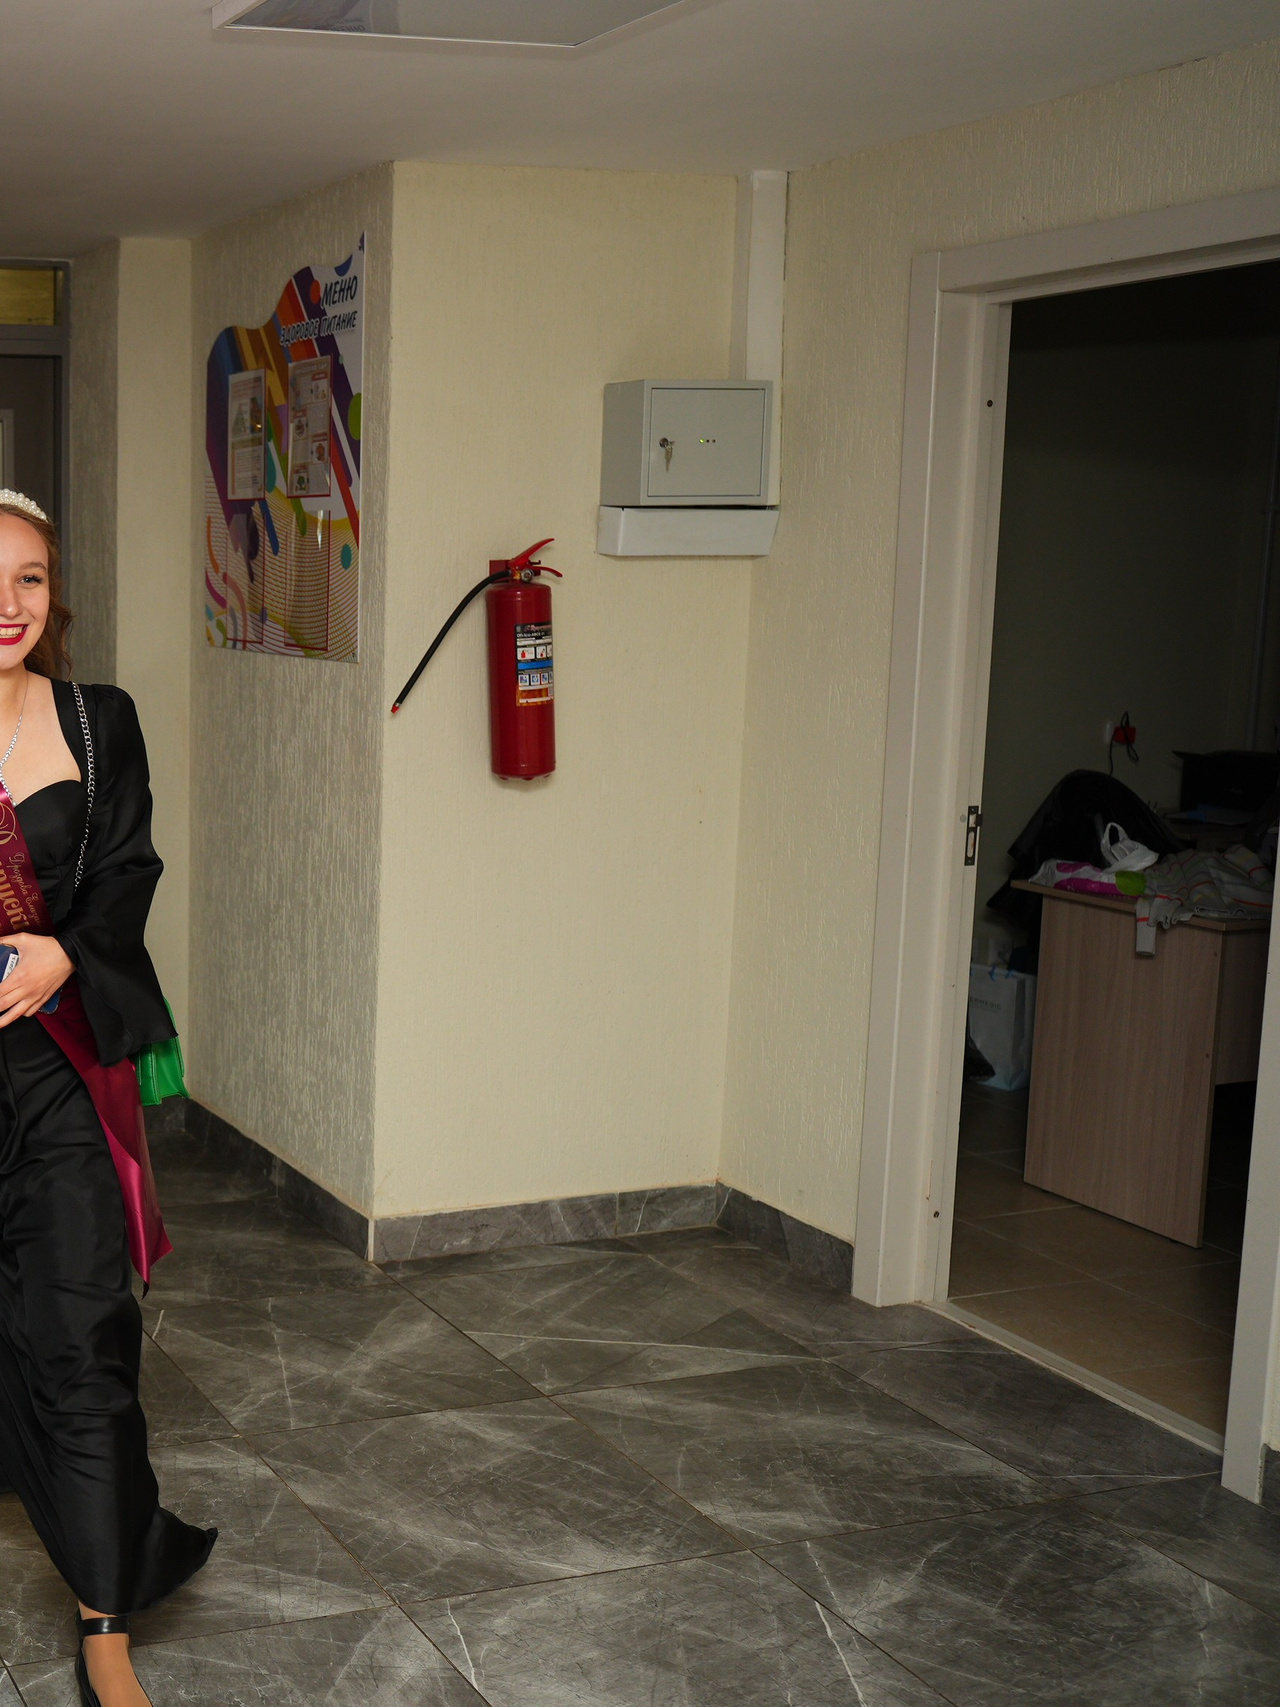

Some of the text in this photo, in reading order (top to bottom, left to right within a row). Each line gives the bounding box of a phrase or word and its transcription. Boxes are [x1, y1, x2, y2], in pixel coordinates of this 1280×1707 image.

[321, 275, 358, 307] МЕНЮ
[280, 310, 358, 347] ЗДОРОВОЕ ПИТАНИЕ
